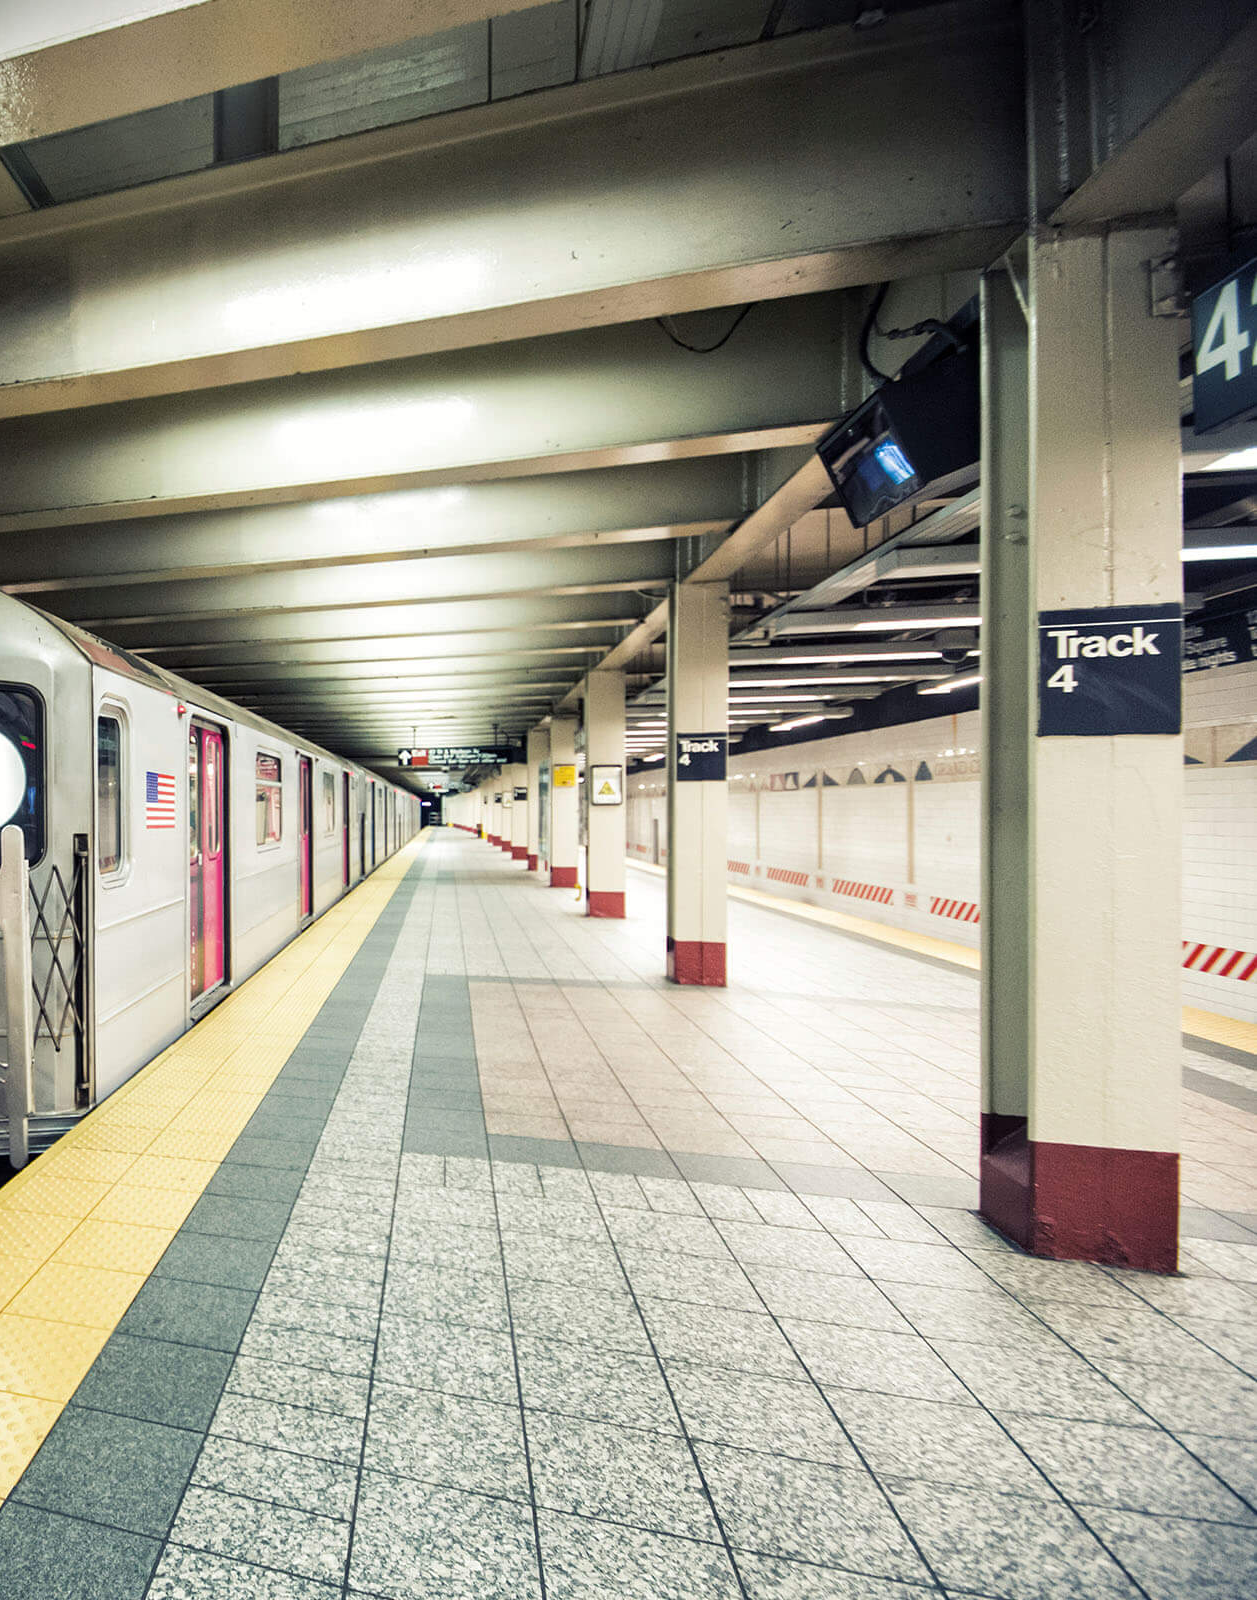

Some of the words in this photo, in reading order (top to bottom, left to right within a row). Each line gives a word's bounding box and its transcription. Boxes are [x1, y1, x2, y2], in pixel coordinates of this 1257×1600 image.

[1196, 272, 1257, 381] 4
[1047, 627, 1161, 659] Track
[1047, 664, 1078, 693] 4
[678, 753, 691, 766] 4
[679, 740, 719, 752] Track
